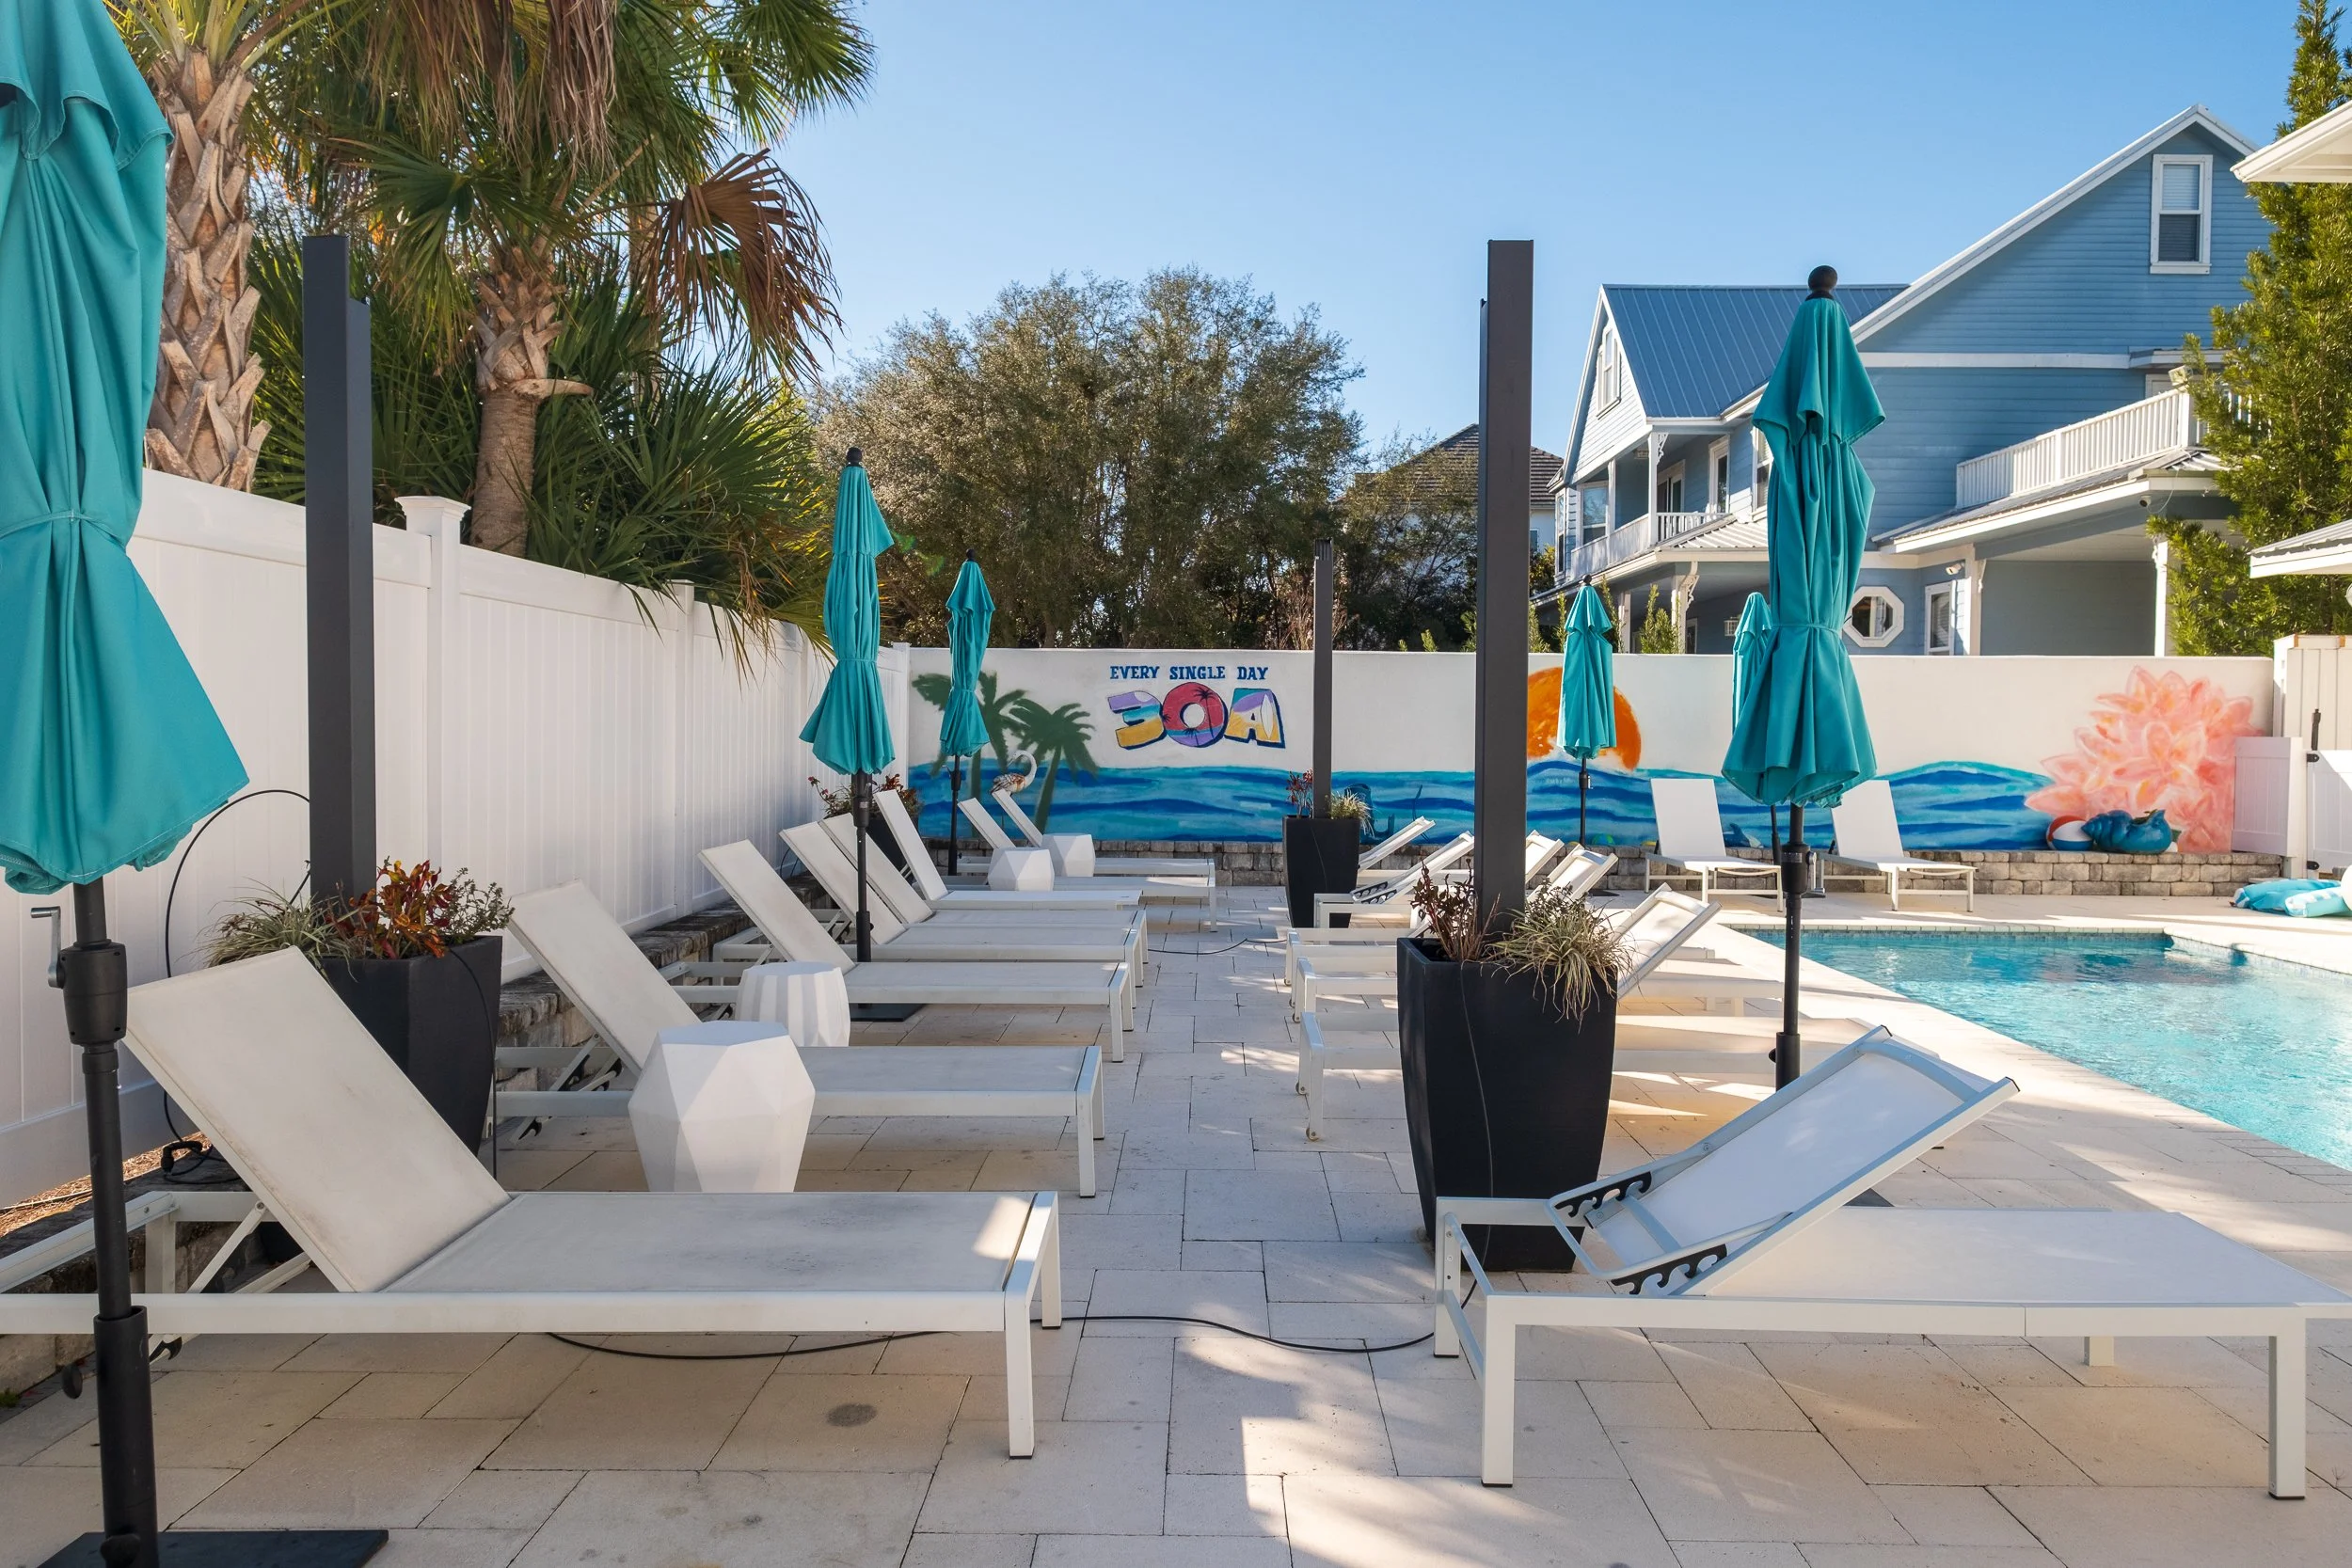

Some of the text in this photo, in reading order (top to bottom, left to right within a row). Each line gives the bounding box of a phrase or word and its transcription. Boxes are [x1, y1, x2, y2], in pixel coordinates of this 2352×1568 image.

[1109, 665, 1269, 680] EVERY SINGLE DAY
